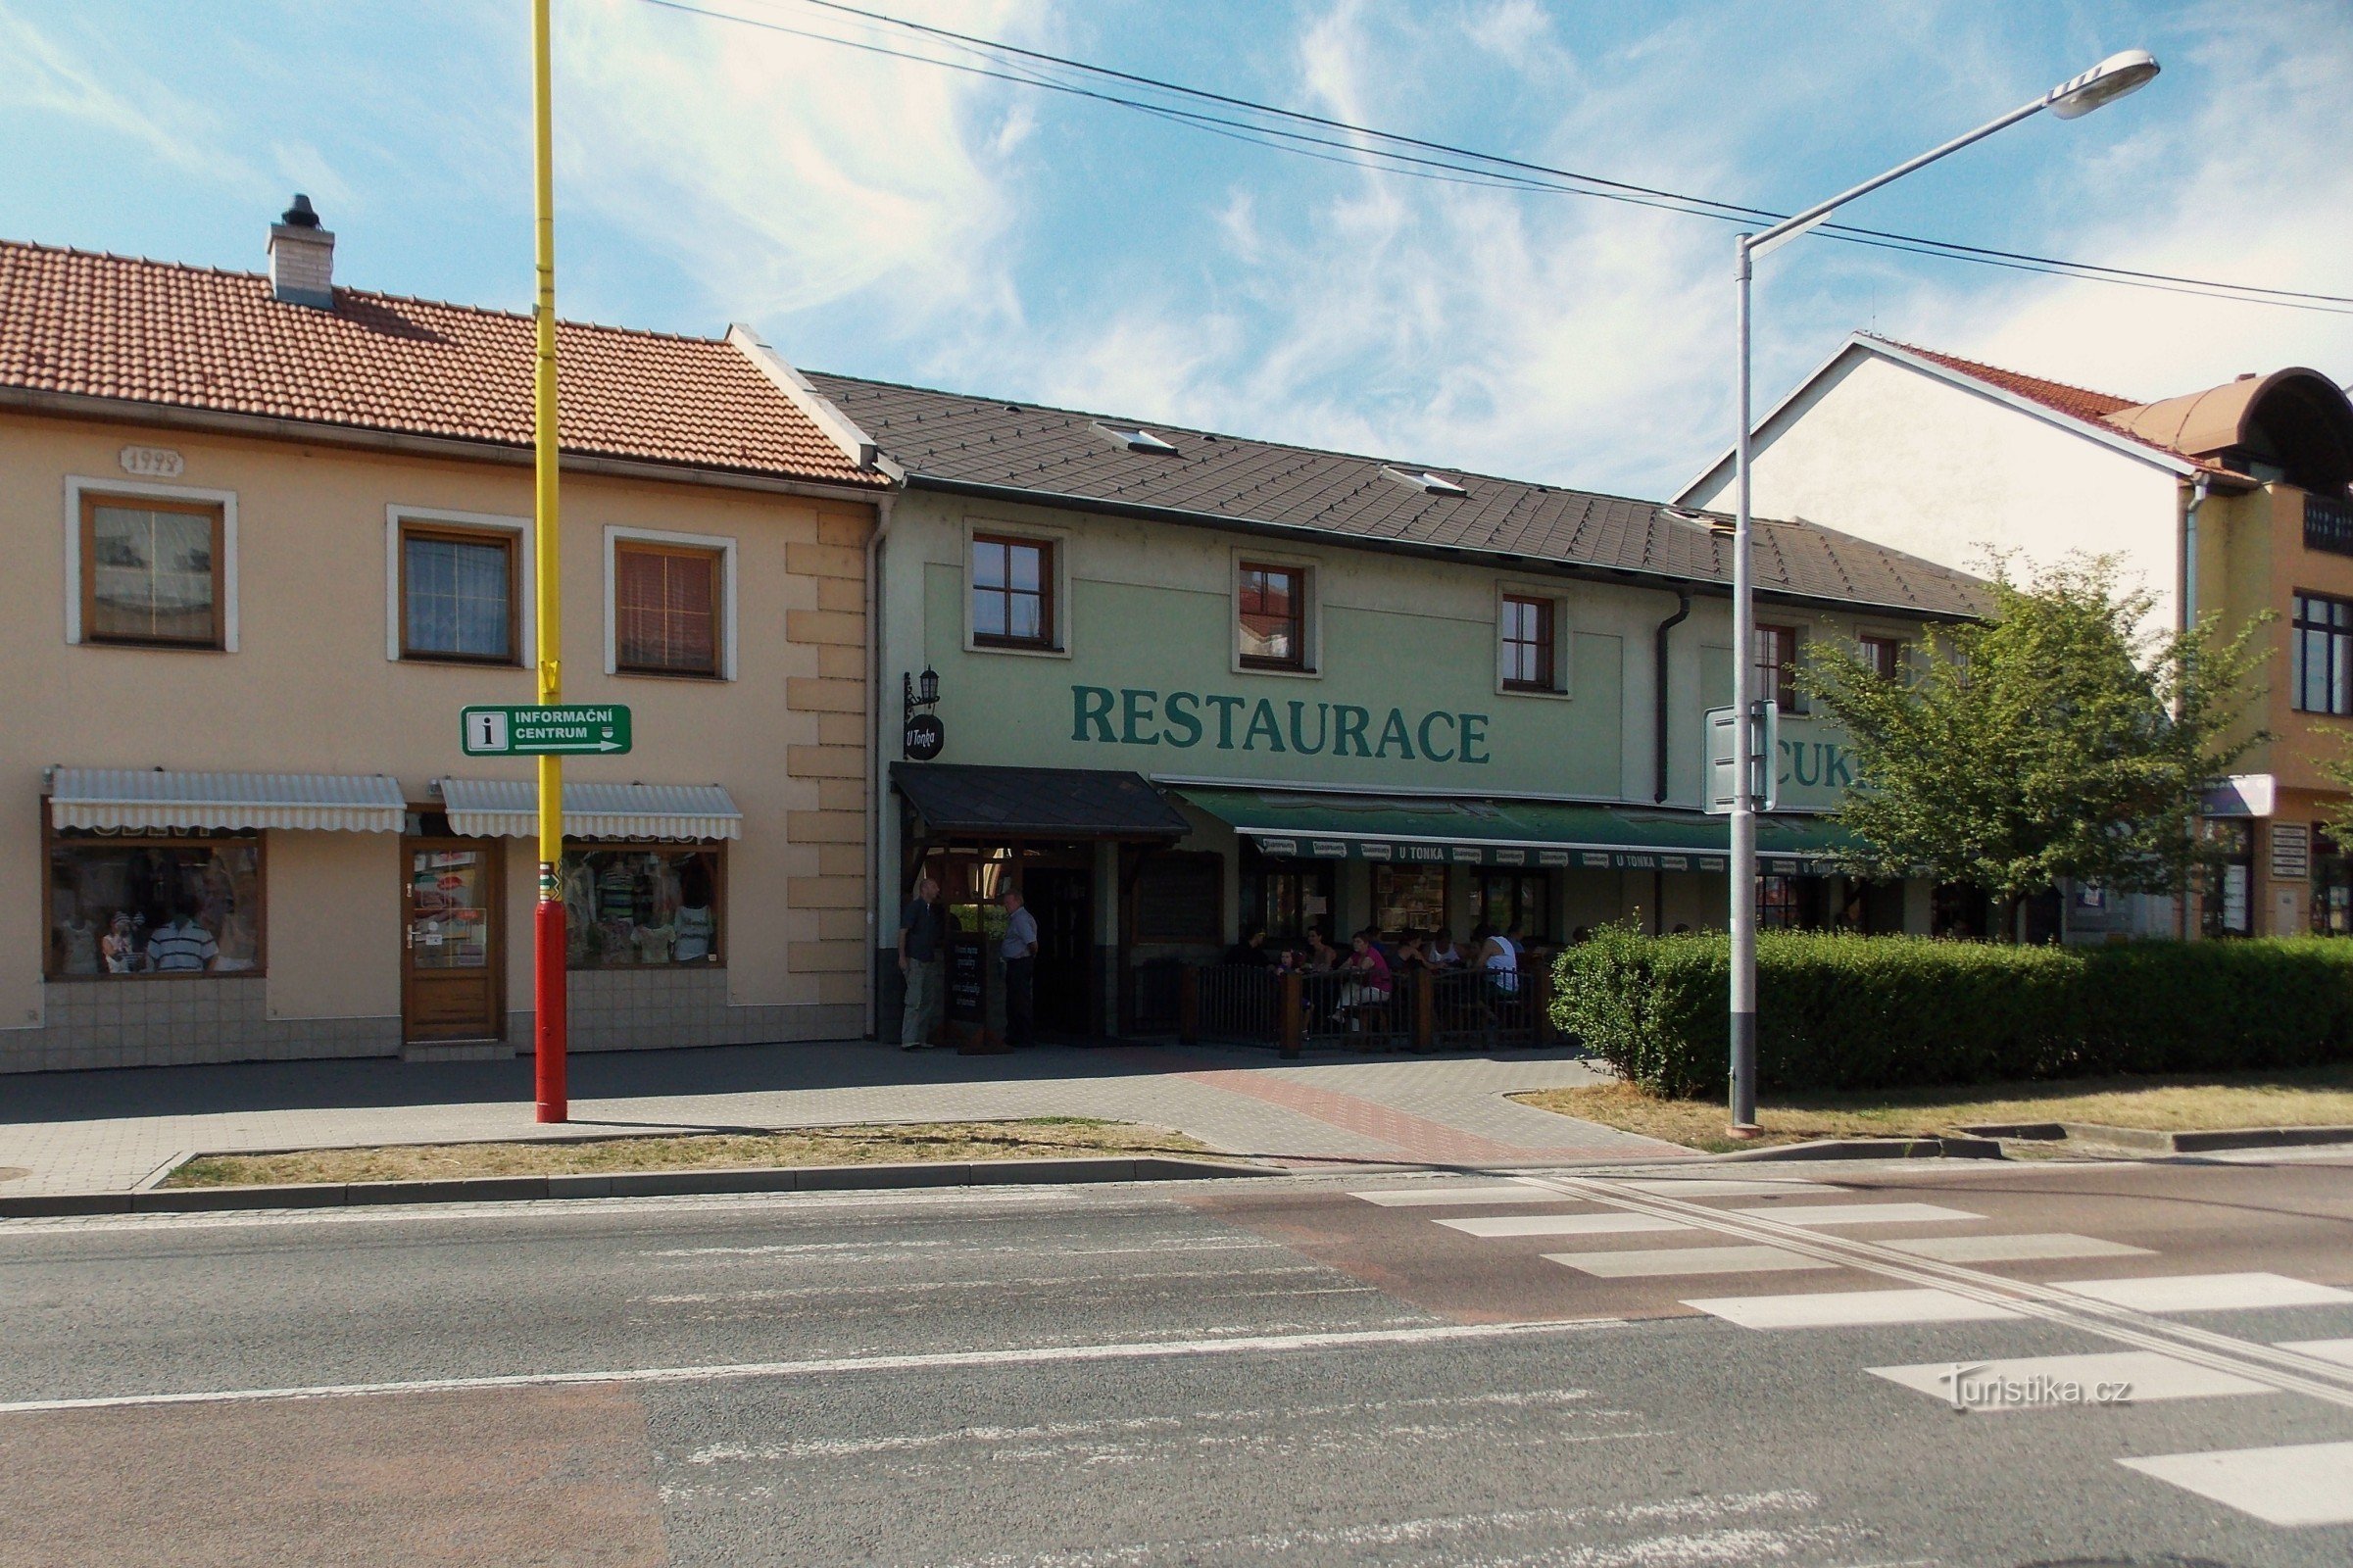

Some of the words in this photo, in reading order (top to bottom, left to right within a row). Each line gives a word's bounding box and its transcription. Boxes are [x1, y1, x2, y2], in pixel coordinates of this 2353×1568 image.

[515, 708, 613, 723] INFORMAČNÍ
[1070, 684, 1491, 764] RESTAURACE
[515, 727, 588, 739] CENTRUM
[907, 730, 913, 747] U
[1398, 846, 1406, 859] U
[1410, 846, 1445, 860] TONKA
[1616, 854, 1624, 866] U
[1627, 855, 1655, 867] TONKA
